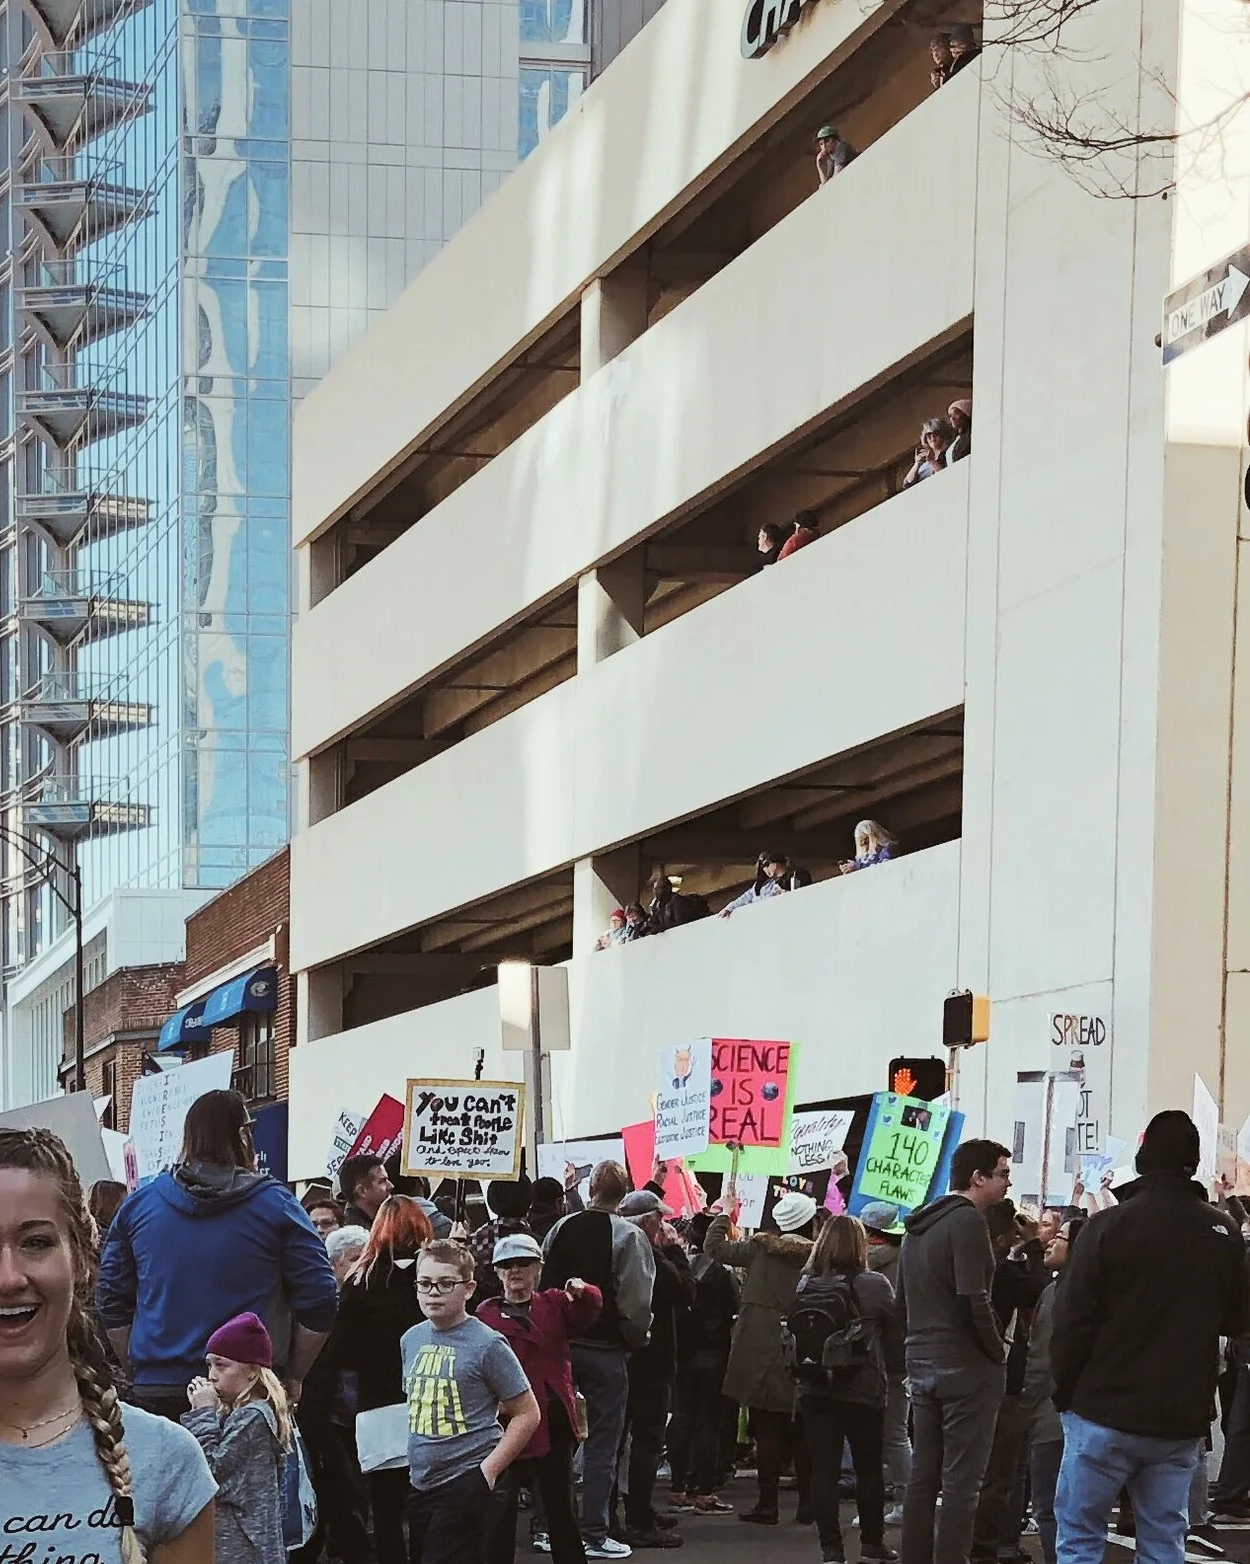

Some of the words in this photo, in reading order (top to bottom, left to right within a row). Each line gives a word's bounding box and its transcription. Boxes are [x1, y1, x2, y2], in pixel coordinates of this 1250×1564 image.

[1171, 304, 1196, 338] ONE
[1200, 282, 1226, 319] WAY
[1051, 1014, 1106, 1046] SPREAD
[731, 1077, 754, 1106] IS
[339, 1112, 357, 1137] KEEP
[709, 1105, 780, 1141] REAL
[791, 1140, 833, 1156] NOTHING
[884, 1132, 929, 1166] 140
[866, 1157, 931, 1187] CHARACTER
[879, 1180, 916, 1202] FLAWS
[3, 1511, 82, 1535] can
[87, 1494, 123, 1529] do
